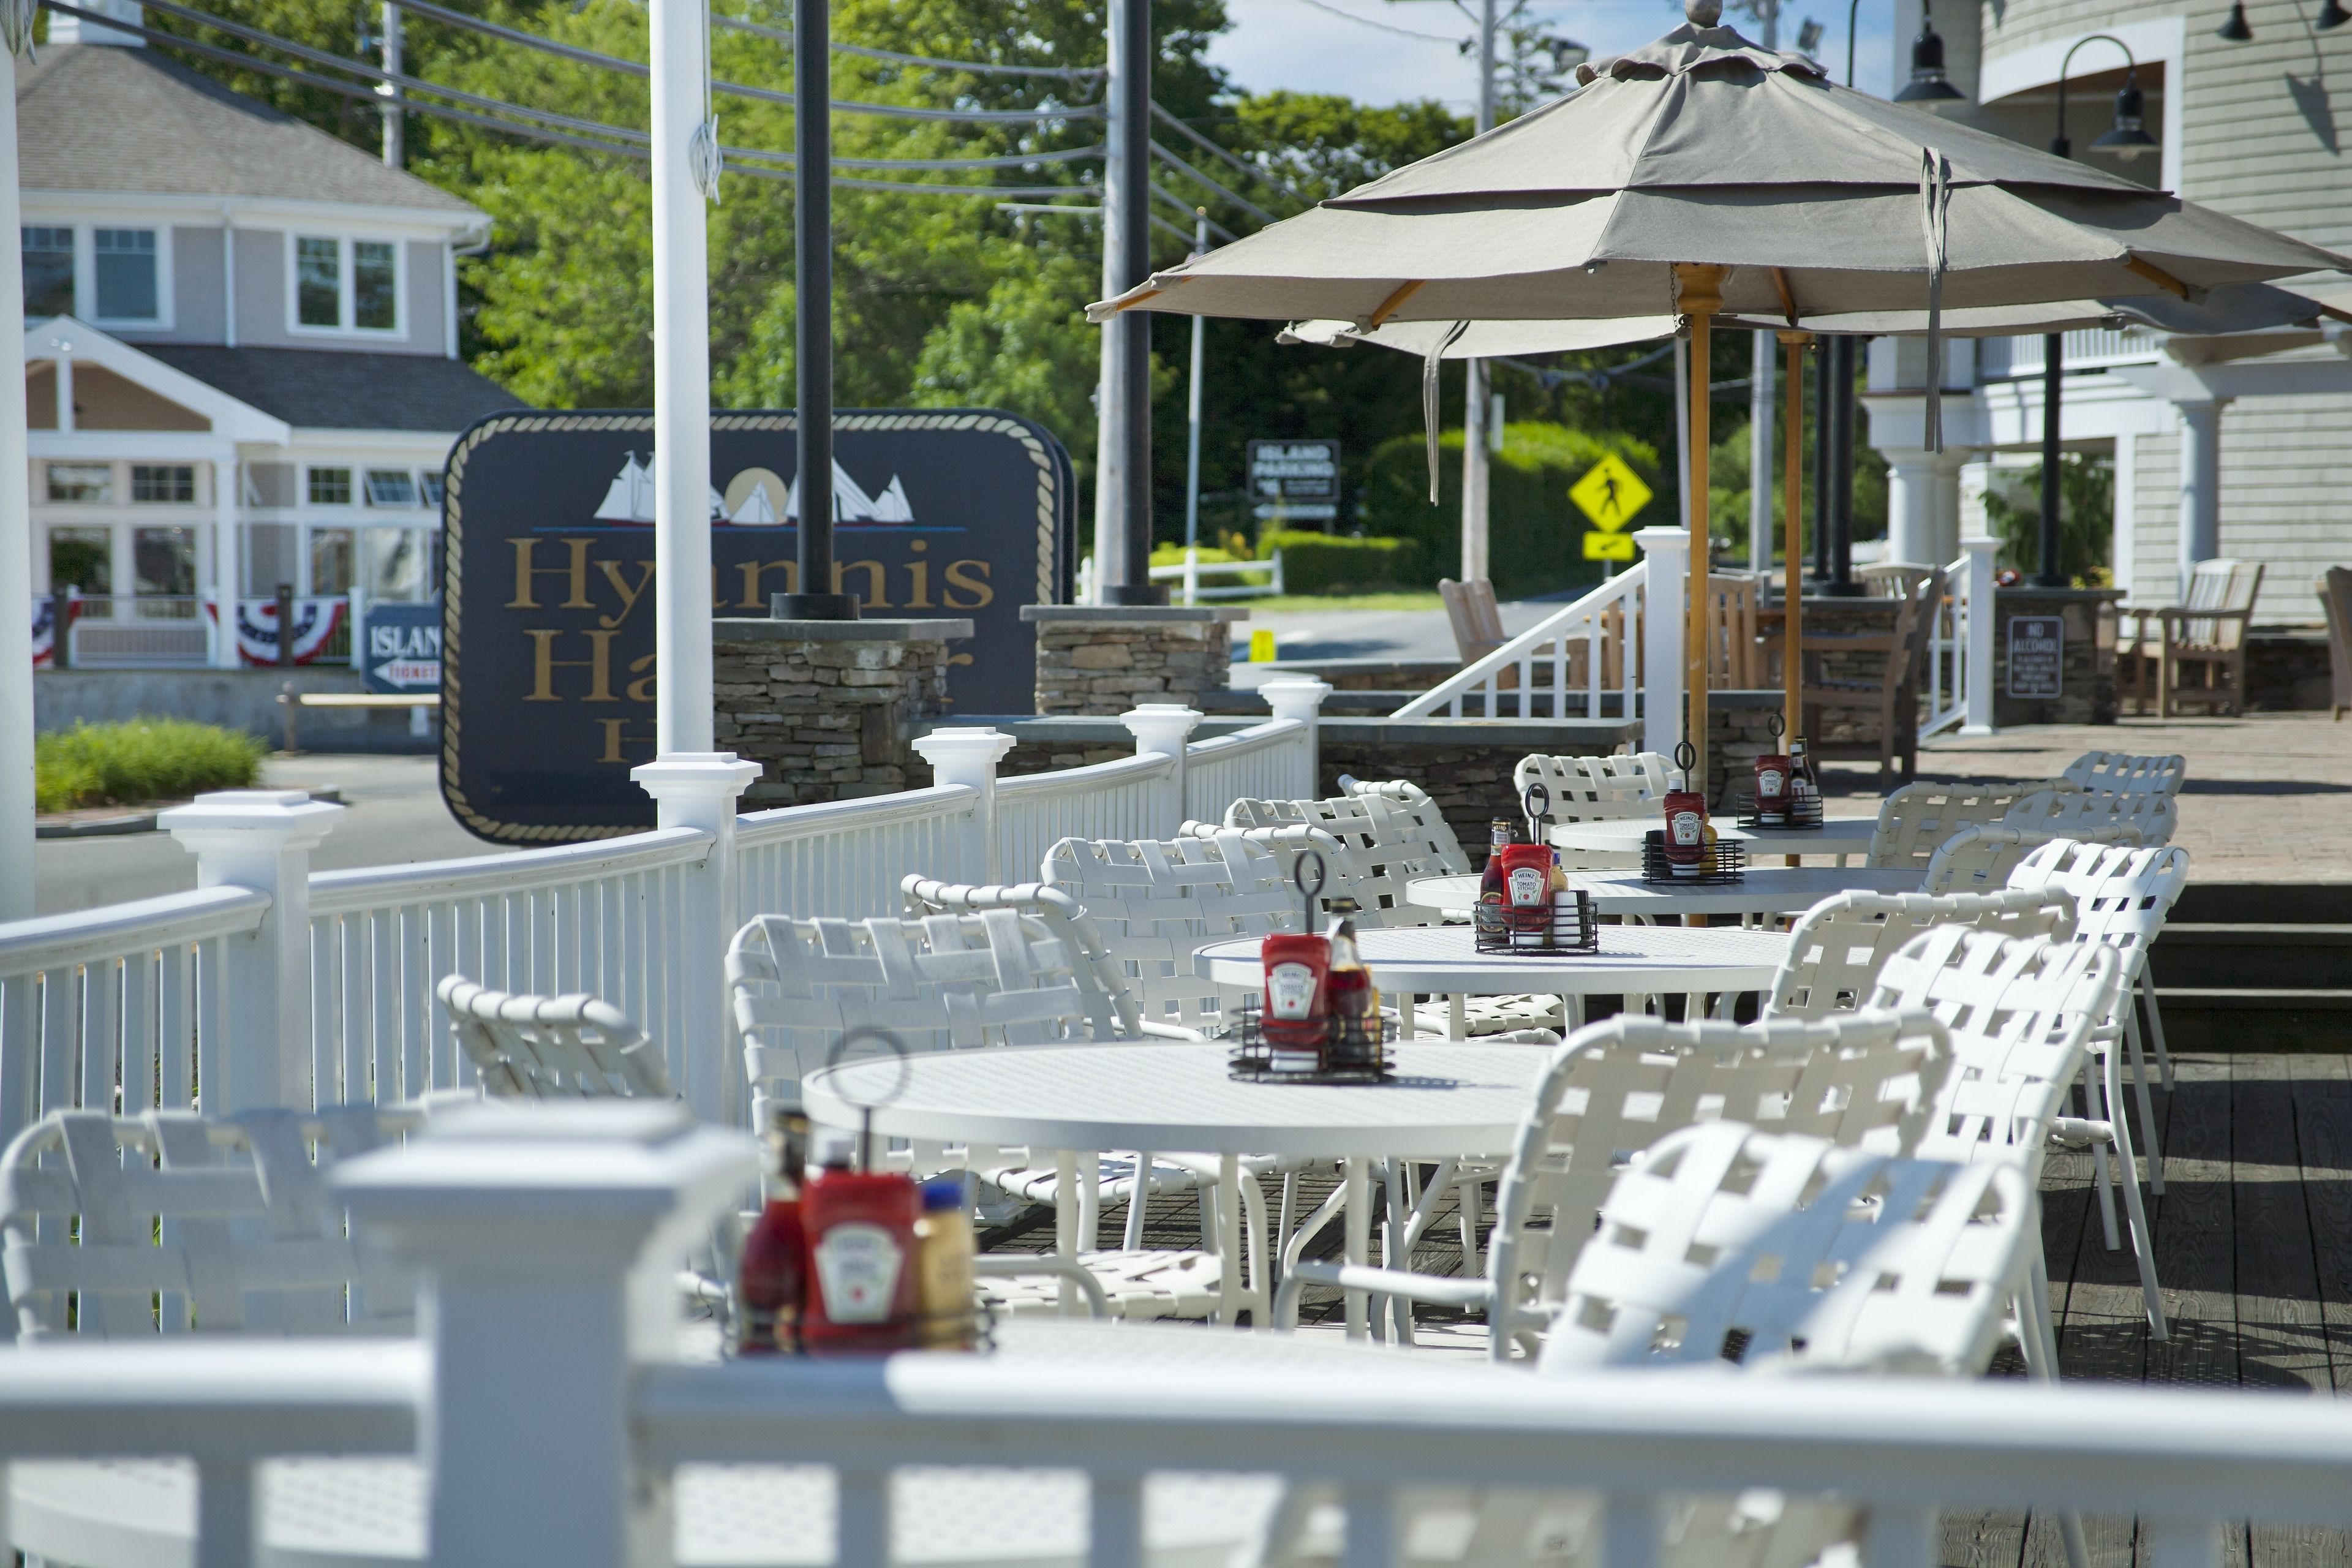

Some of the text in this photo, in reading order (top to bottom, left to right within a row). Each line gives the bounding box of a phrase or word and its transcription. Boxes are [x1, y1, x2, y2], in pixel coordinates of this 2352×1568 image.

[2027, 622, 2044, 638] NO
[370, 625, 440, 657] ISLAN
[2014, 639, 2057, 654] ALCOHOL
